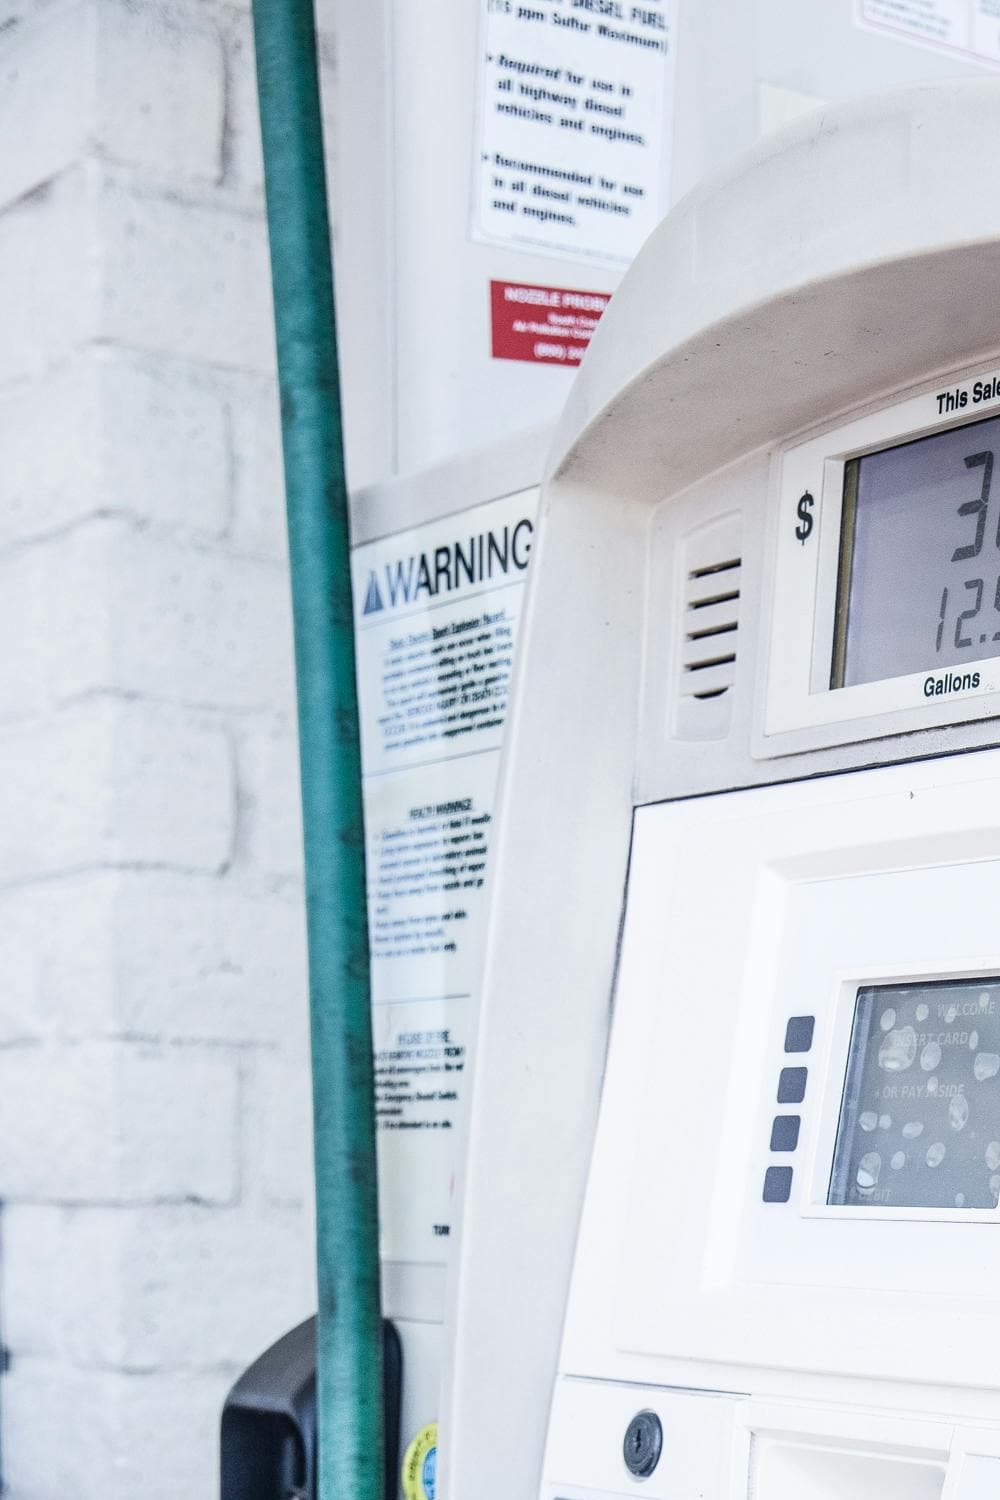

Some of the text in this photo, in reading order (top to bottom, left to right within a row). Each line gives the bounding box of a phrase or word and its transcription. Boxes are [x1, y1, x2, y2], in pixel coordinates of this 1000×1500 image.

[553, 13, 591, 32] Sulfur
[499, 55, 561, 79] Required
[567, 71, 584, 85] for
[519, 83, 577, 109] highway
[497, 102, 553, 123] vehicles
[560, 117, 584, 130] and
[495, 154, 593, 185] Recommended
[936, 390, 968, 415] This
[795, 490, 815, 546] $
[386, 518, 534, 608] WARNING
[923, 669, 981, 697] Gallons
